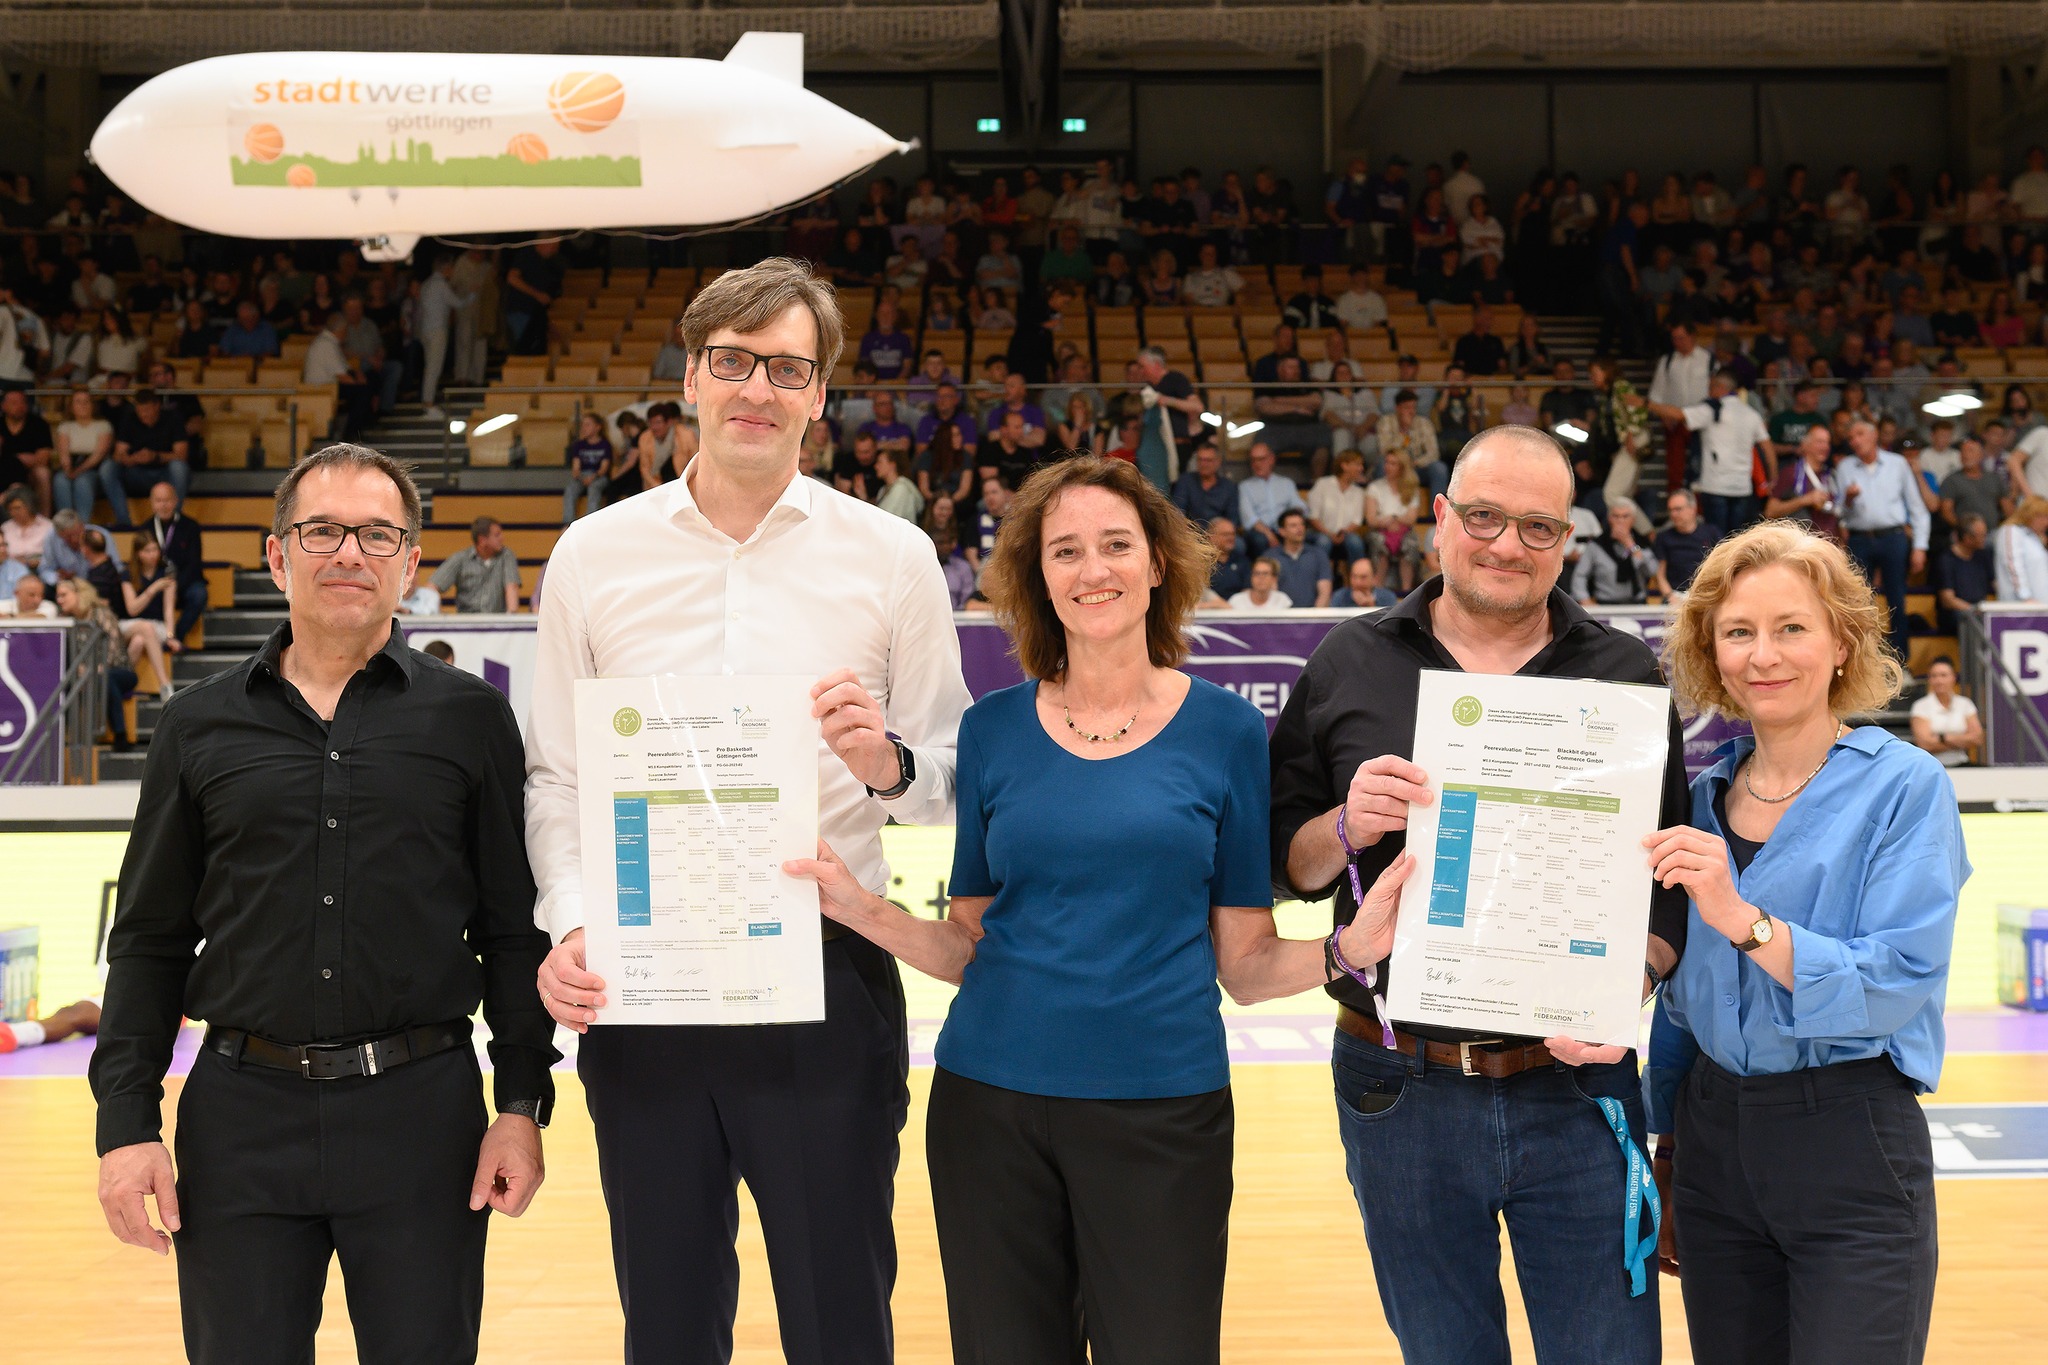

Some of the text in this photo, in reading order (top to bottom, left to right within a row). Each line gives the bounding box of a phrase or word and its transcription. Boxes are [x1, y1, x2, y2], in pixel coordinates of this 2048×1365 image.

[254, 76, 492, 104] stadtwerke
[387, 112, 492, 134] göttingen
[1534, 1007, 1580, 1016] INTERNATIONAL
[1534, 1013, 1572, 1021] FEDERATION
